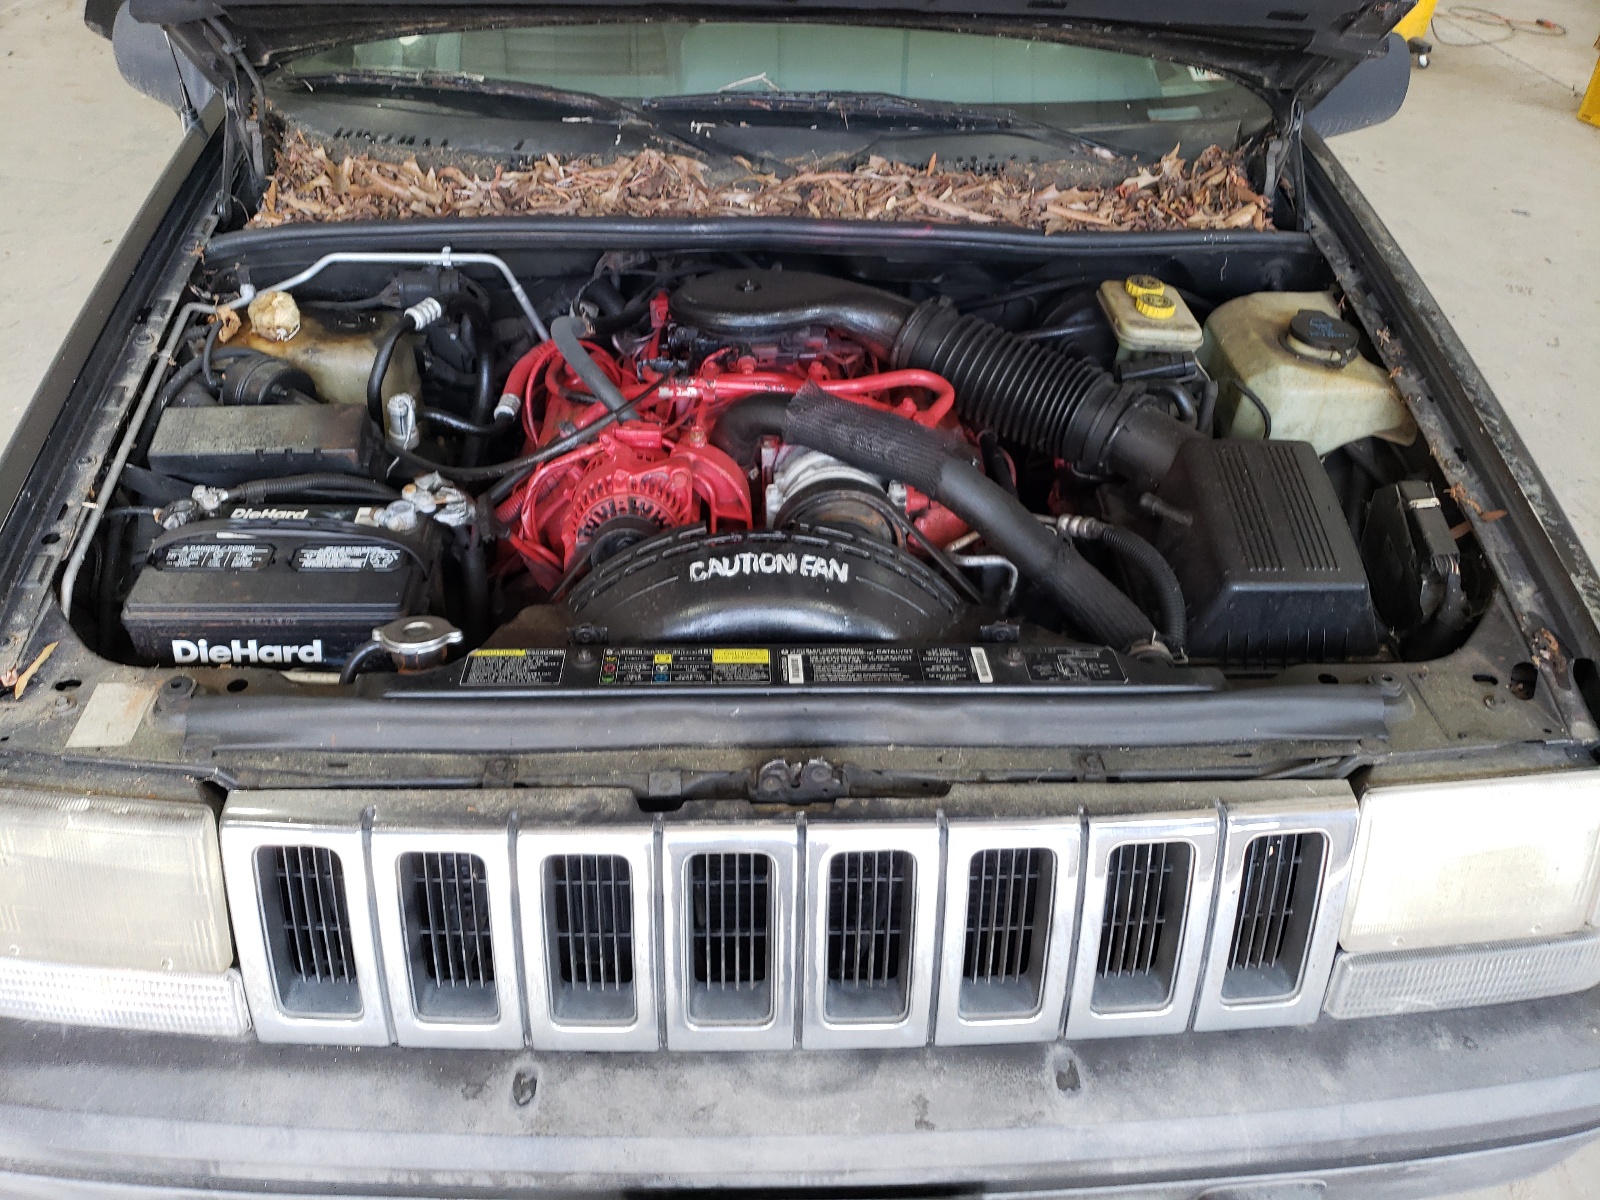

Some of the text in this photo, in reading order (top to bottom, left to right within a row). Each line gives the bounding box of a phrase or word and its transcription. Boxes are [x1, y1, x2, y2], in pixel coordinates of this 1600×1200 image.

[230, 508, 309, 520] DieHard
[689, 552, 849, 583] CAUTION FAN
[171, 638, 323, 663] DieHard
